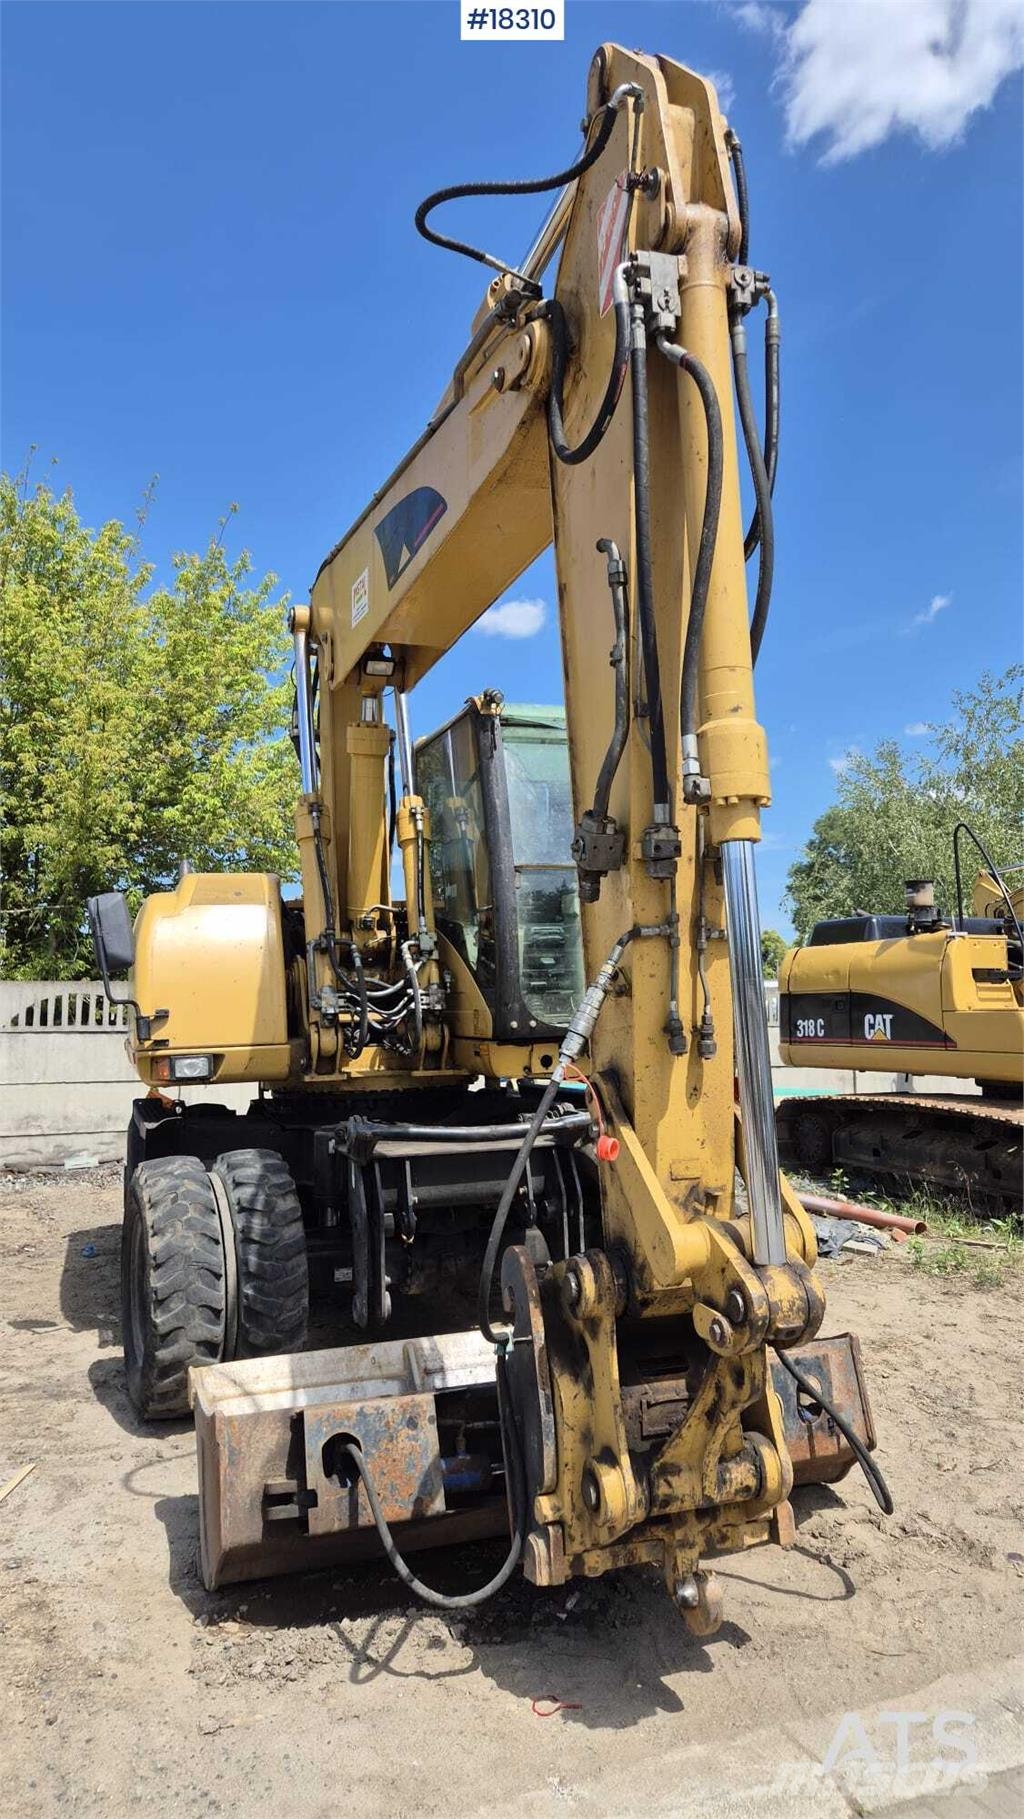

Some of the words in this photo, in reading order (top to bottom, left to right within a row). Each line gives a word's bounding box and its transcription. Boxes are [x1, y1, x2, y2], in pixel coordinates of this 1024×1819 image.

[796, 1019, 816, 1038] 318
[816, 1018, 825, 1038] C
[864, 1013, 894, 1041] CAT
